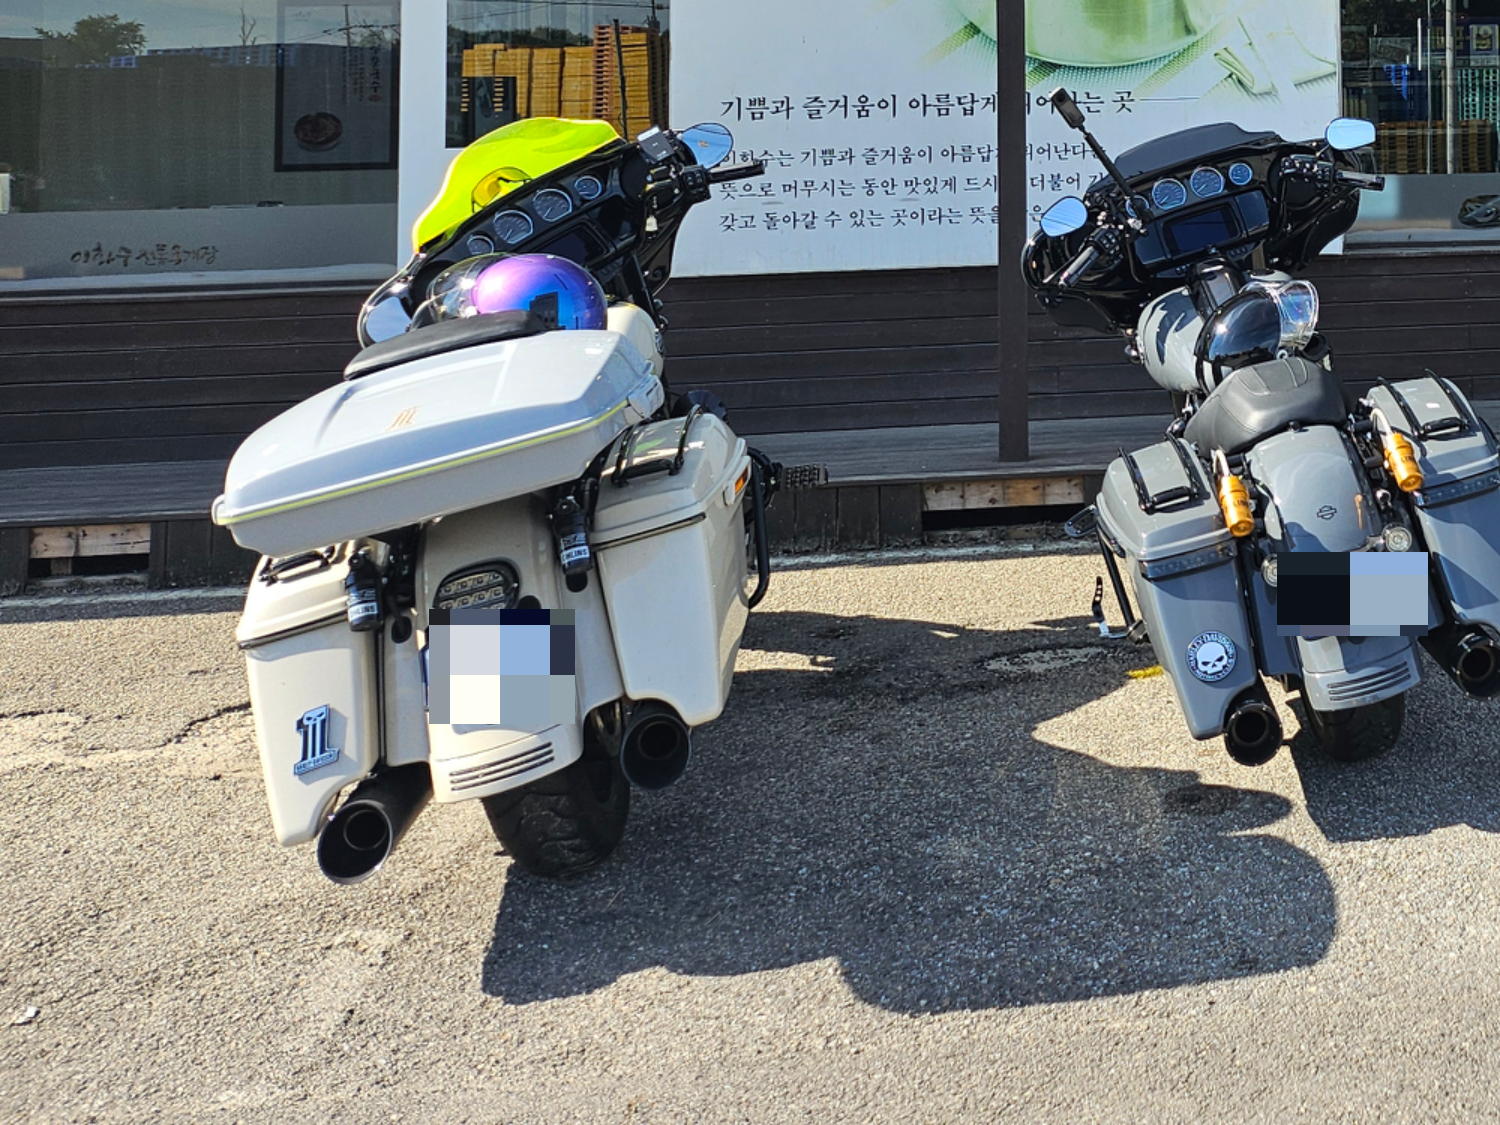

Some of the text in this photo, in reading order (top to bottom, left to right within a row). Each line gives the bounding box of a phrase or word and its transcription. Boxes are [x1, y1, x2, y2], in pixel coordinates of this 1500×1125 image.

[720, 95, 795, 122] 기쁨과
[802, 94, 897, 120] 즐거움이
[1111, 90, 1136, 114] 곳
[800, 146, 856, 168] 기쁨과
[862, 145, 934, 166] 즐거움이
[940, 143, 998, 165] 아름답
[718, 181, 776, 201] 뜻으로
[781, 178, 856, 199] 머무시는
[861, 178, 898, 198] 동안
[903, 175, 957, 196] 맛있게
[1029, 172, 1080, 192] 더불어
[718, 212, 757, 233] 갖고
[762, 209, 819, 231] 돌아갈
[823, 210, 843, 229] 수
[849, 208, 885, 229] 있는
[890, 206, 963, 227] 곳이라는
